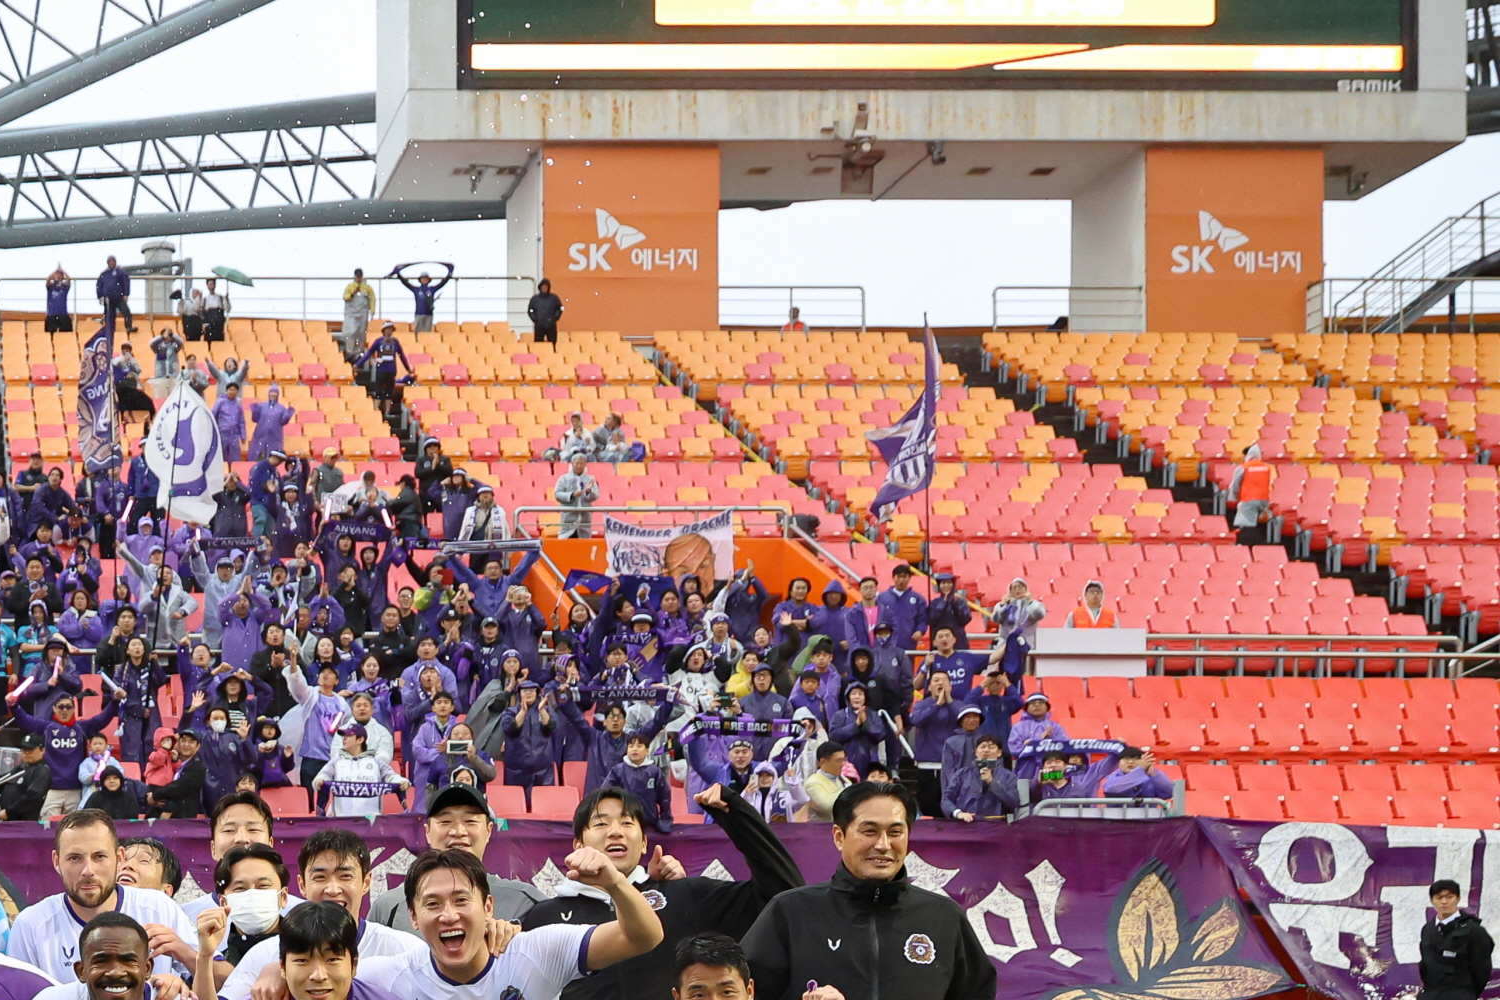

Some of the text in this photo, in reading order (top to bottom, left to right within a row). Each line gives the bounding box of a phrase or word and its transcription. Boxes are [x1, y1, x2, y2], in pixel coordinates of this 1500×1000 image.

[568, 242, 698, 272] SK 에너지
[1170, 244, 1302, 274] SK 에너지
[333, 523, 377, 537] ANYANG
[605, 517, 672, 538] REMEMBER
[408, 539, 424, 549] FC
[591, 689, 657, 699] FC ANYANG
[696, 720, 721, 730] BOYS
[747, 722, 774, 732] BACK
[51, 738, 78, 749] OHC
[329, 785, 393, 798] ANYANG
